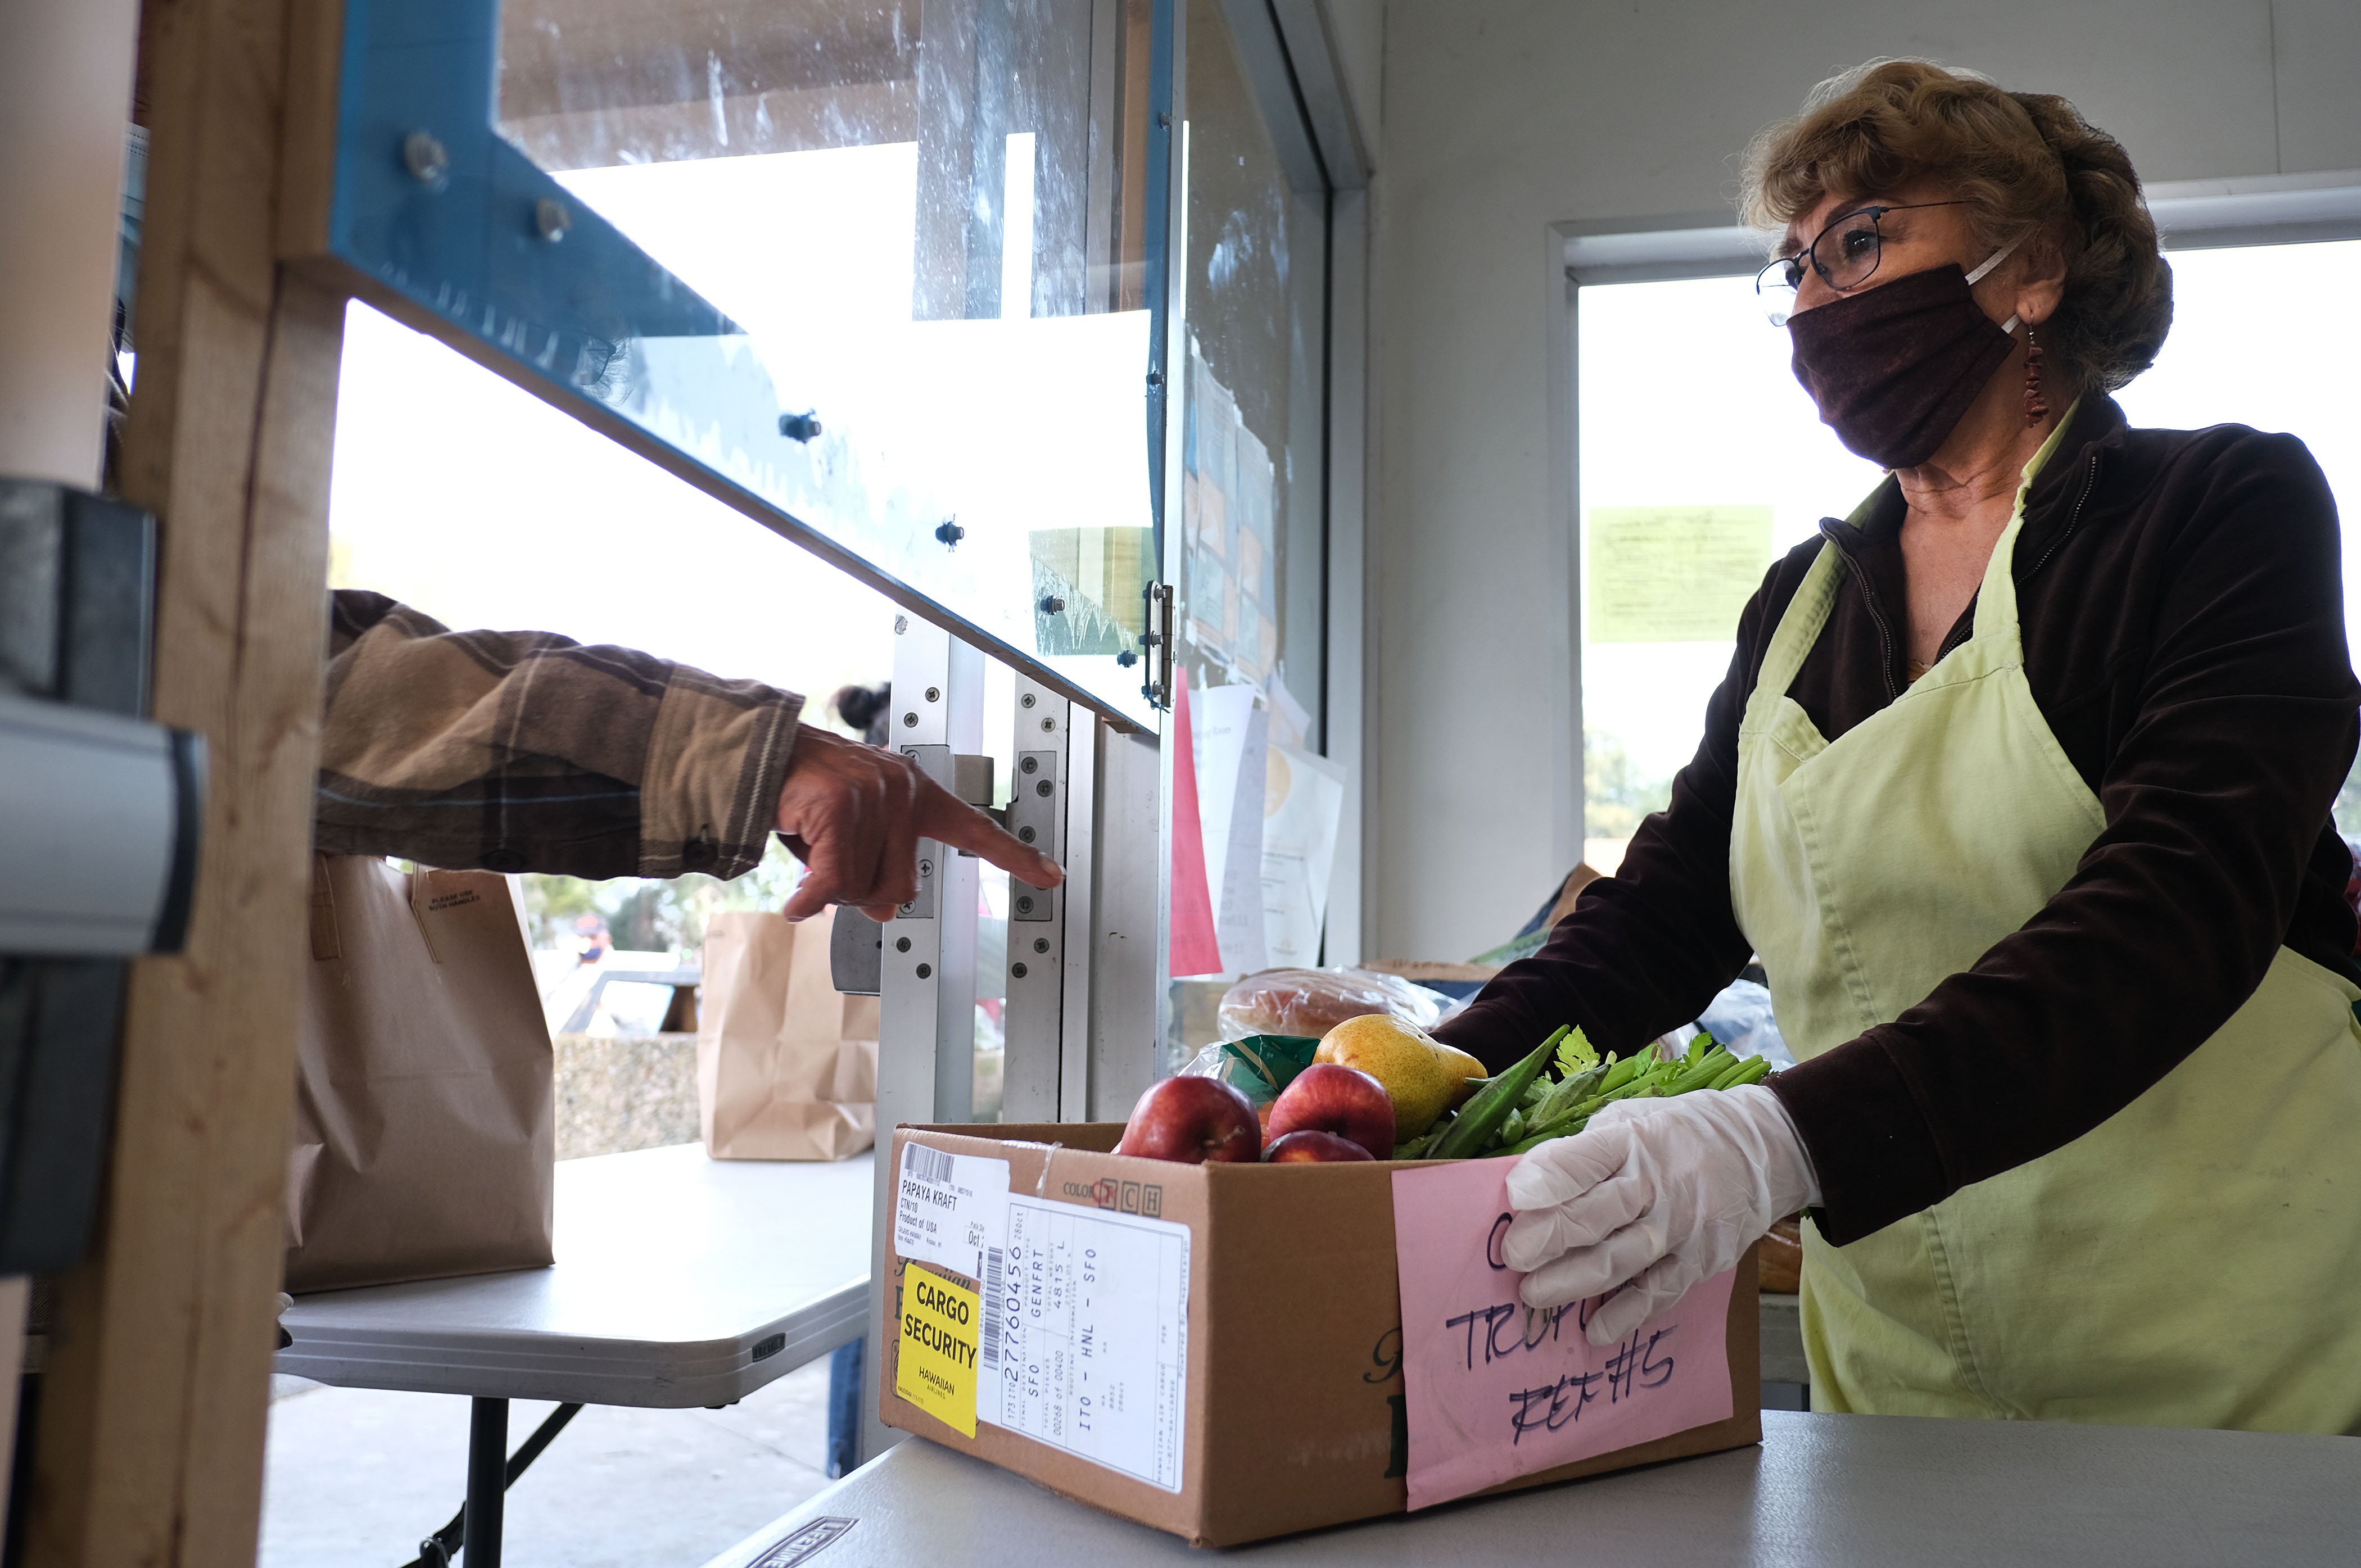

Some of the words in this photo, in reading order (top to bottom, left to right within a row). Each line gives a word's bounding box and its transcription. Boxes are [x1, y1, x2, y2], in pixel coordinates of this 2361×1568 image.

[901, 1197, 919, 1214] CTN/10
[902, 1179, 930, 1203] PAPAYA
[933, 1189, 957, 1211] KRAFT
[1063, 1181, 1094, 1199] COLOR
[1126, 1188, 1135, 1207] C
[1147, 1191, 1158, 1211] H
[899, 1210, 917, 1226] Product
[919, 1217, 925, 1229] of
[926, 1220, 937, 1234] USA
[1014, 1211, 1024, 1241] 280ct
[968, 1230, 980, 1246] Oct
[1056, 1240, 1064, 1250] L
[1083, 1248, 1096, 1283] SFO
[1031, 1248, 1044, 1318] GENFRT
[1053, 1263, 1064, 1309] 4815
[916, 1281, 970, 1325] CARGO
[1004, 1245, 1021, 1383] 27760456
[904, 1313, 978, 1370] SECURITY
[1081, 1324, 1093, 1358] HNL
[919, 1365, 955, 1396] HAWAIIAN
[1008, 1382, 1016, 1400] ITO
[1028, 1363, 1039, 1398] SFO
[1054, 1386, 1063, 1399] of
[1007, 1402, 1016, 1420] 173
[1079, 1396, 1091, 1431] ITO
